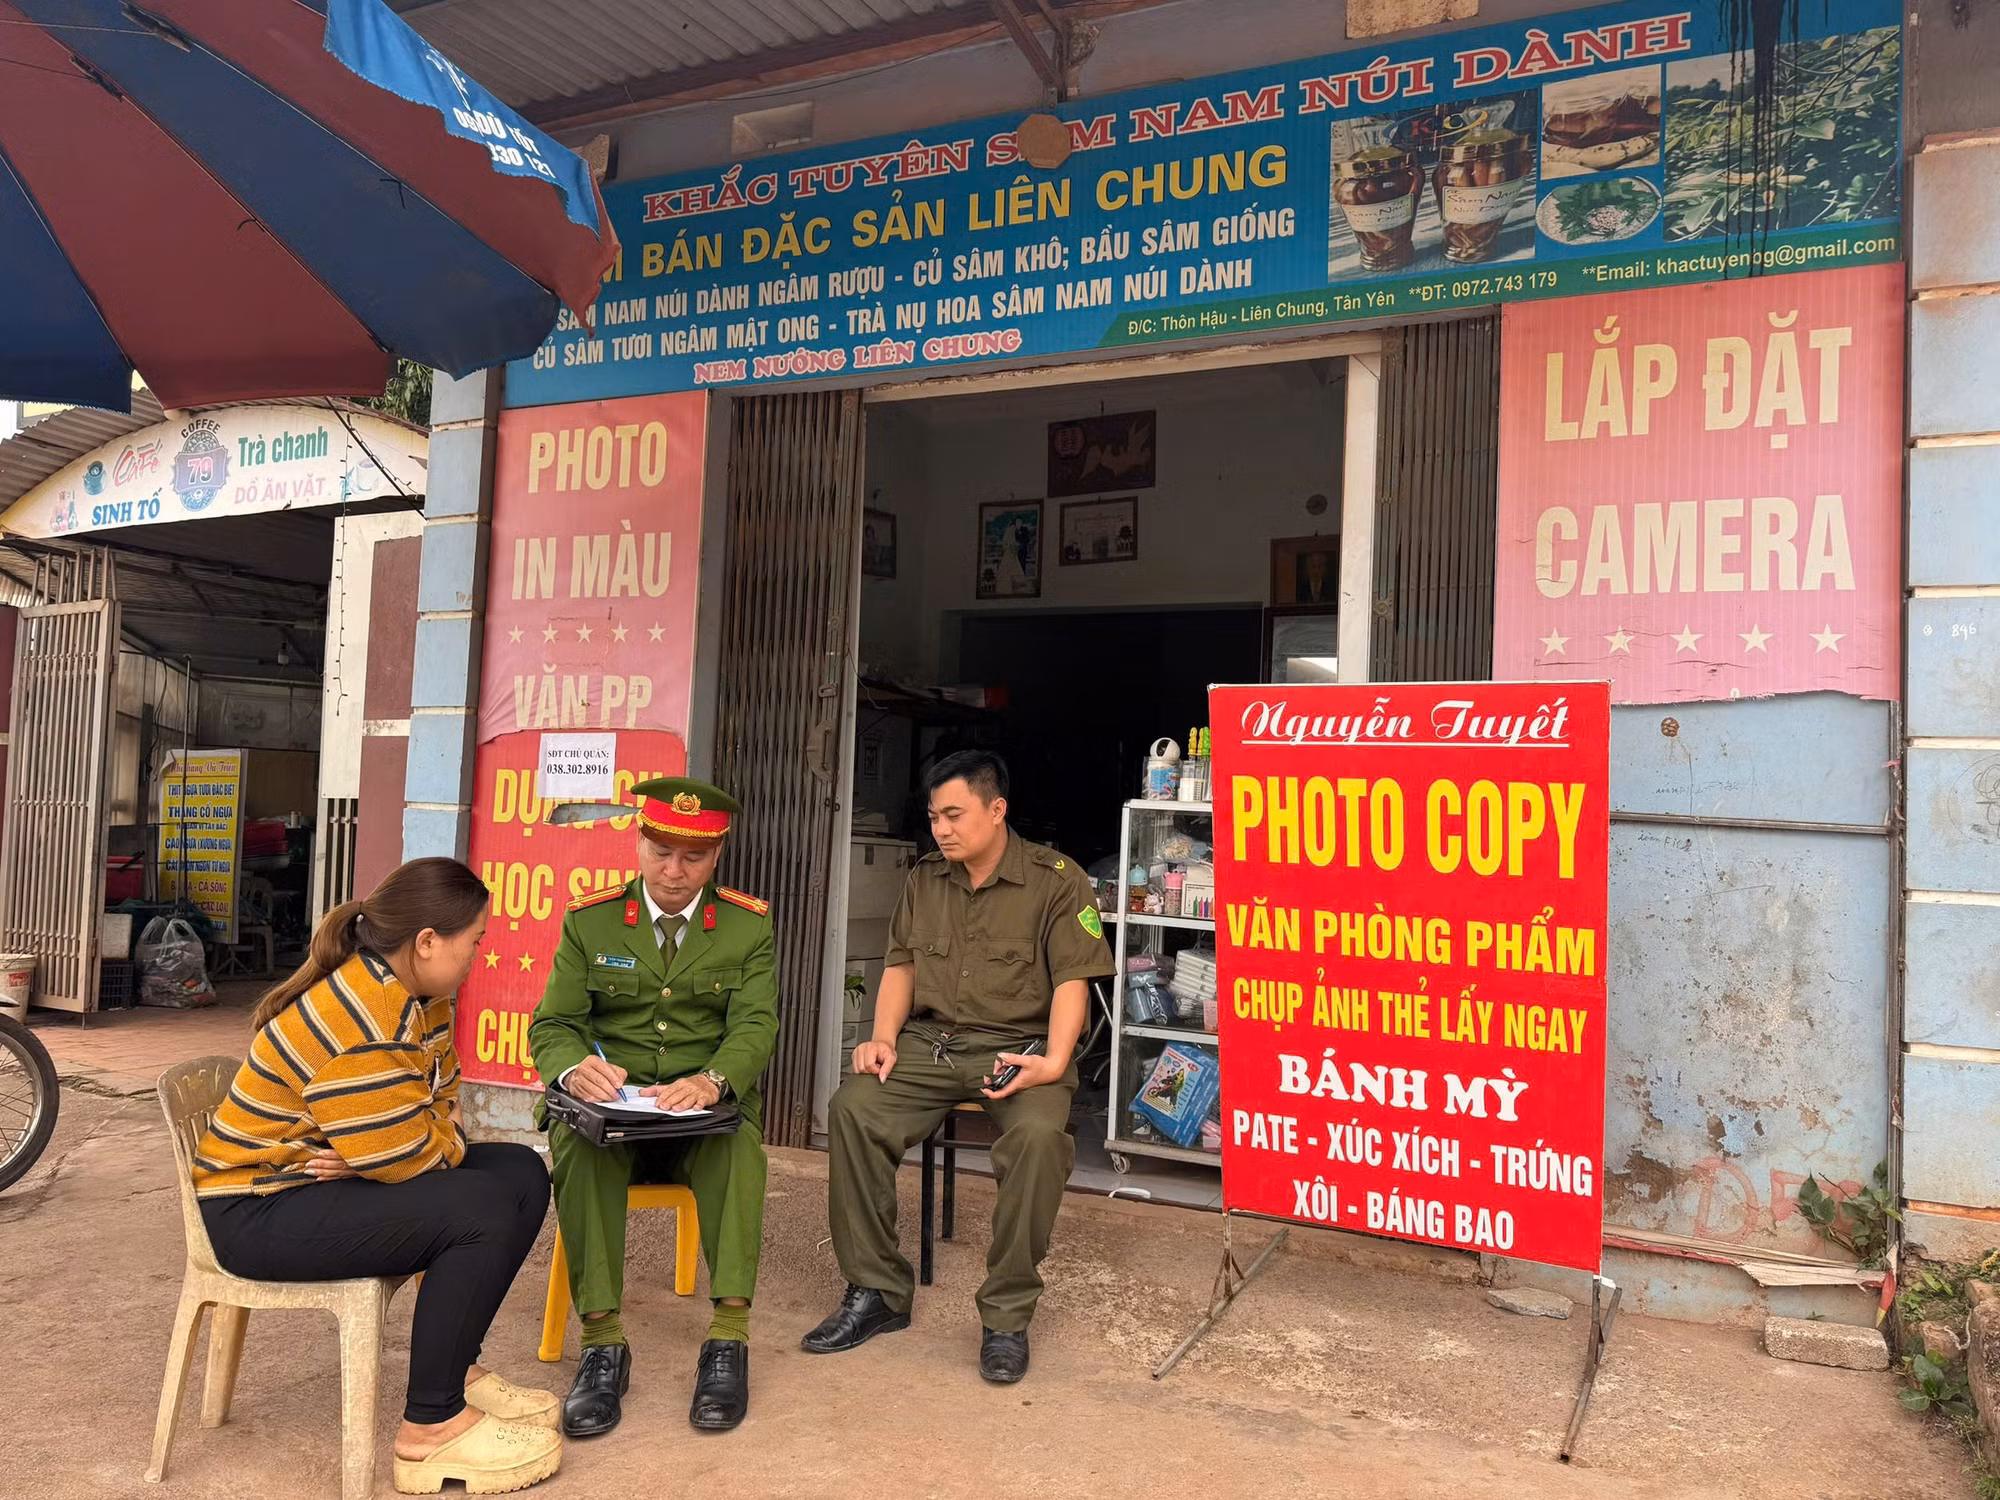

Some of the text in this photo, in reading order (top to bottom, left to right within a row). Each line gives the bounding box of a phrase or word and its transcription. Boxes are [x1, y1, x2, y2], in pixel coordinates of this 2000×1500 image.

[643, 12, 1691, 222] KHẮC TUYÊN SM NAM NÚI DÀNH
[643, 228, 722, 277] BÁN
[741, 211, 832, 269] ĐẶC
[852, 189, 945, 247] SẢN
[969, 175, 1071, 231] LIÊN
[1096, 145, 1287, 211] CHUNG
[605, 298, 647, 326] NAM
[656, 287, 688, 320] NÚI
[697, 283, 749, 314] DÀNH
[759, 272, 818, 306] NGÂM
[828, 266, 885, 300] RƯỢU
[913, 247, 943, 288] CỦ
[953, 248, 1004, 282] SÂM
[1015, 235, 1069, 273] KHÔ;
[1081, 224, 1130, 264] BẦU
[1142, 219, 1200, 256] SÂM
[1213, 202, 1295, 247] GIỐNG
[533, 336, 556, 370] CỦ
[563, 337, 604, 367] SÂM
[612, 333, 652, 360] TƯƠI
[661, 325, 717, 356] NGÂM
[727, 318, 768, 352] MẬT
[777, 314, 819, 344] ONG
[846, 301, 886, 336] TRÀ
[896, 302, 926, 334] NỤ
[937, 295, 981, 325] HOA
[992, 284, 1045, 319] SÂM
[1056, 277, 1112, 311] NAM
[1124, 266, 1168, 302] NÚI
[1180, 258, 1252, 295] DÀNH
[1128, 318, 1157, 336] Đ/C:
[1161, 314, 1196, 332] Thôn
[1200, 309, 1227, 330] Hậu
[1241, 304, 1271, 322] Liên
[1276, 299, 1328, 320] Chung,
[1334, 296, 1360, 312] Tân
[1366, 291, 1395, 308] Yên
[1452, 275, 1523, 299] 0972.743
[1530, 271, 1557, 289] 179
[694, 328, 1022, 384] NEM NƯỚNG LIÊN CHUNG
[1544, 310, 1853, 449] LẮP ĐẶT
[181, 419, 220, 438] COFFEE
[238, 426, 328, 467] Trà chanh
[528, 421, 667, 493] PHOTO
[92, 502, 133, 526] SINH
[138, 487, 162, 520] TỐ
[187, 457, 214, 485] 79
[262, 477, 287, 501] ĂN
[294, 473, 326, 502] VẶT
[512, 519, 671, 599] IN MÀU
[1536, 495, 1856, 599] CAMERA
[514, 662, 653, 729] VĂN PP
[1242, 697, 1571, 747] Nguyễn Tuyết
[546, 763, 609, 775] 038.302.8916
[1232, 775, 1586, 879] PHOTO COPY
[482, 861, 554, 931] HỌC
[1226, 896, 1595, 976] VĂN PHÒNG PHẨM
[1233, 968, 1588, 1054] CHỤP ẢNH THẺ LẤY NGAY
[1278, 1047, 1529, 1122] BÁNH MỲ
[1233, 1109, 1299, 1154] PATE
[1326, 1118, 1383, 1168] XÚC
[1392, 1126, 1460, 1178] XÍCH
[1490, 1139, 1593, 1197] TRỨNG
[1293, 1175, 1338, 1223] XÔI
[1367, 1188, 1445, 1240] BÁNG
[1454, 1204, 1515, 1251] BAO
